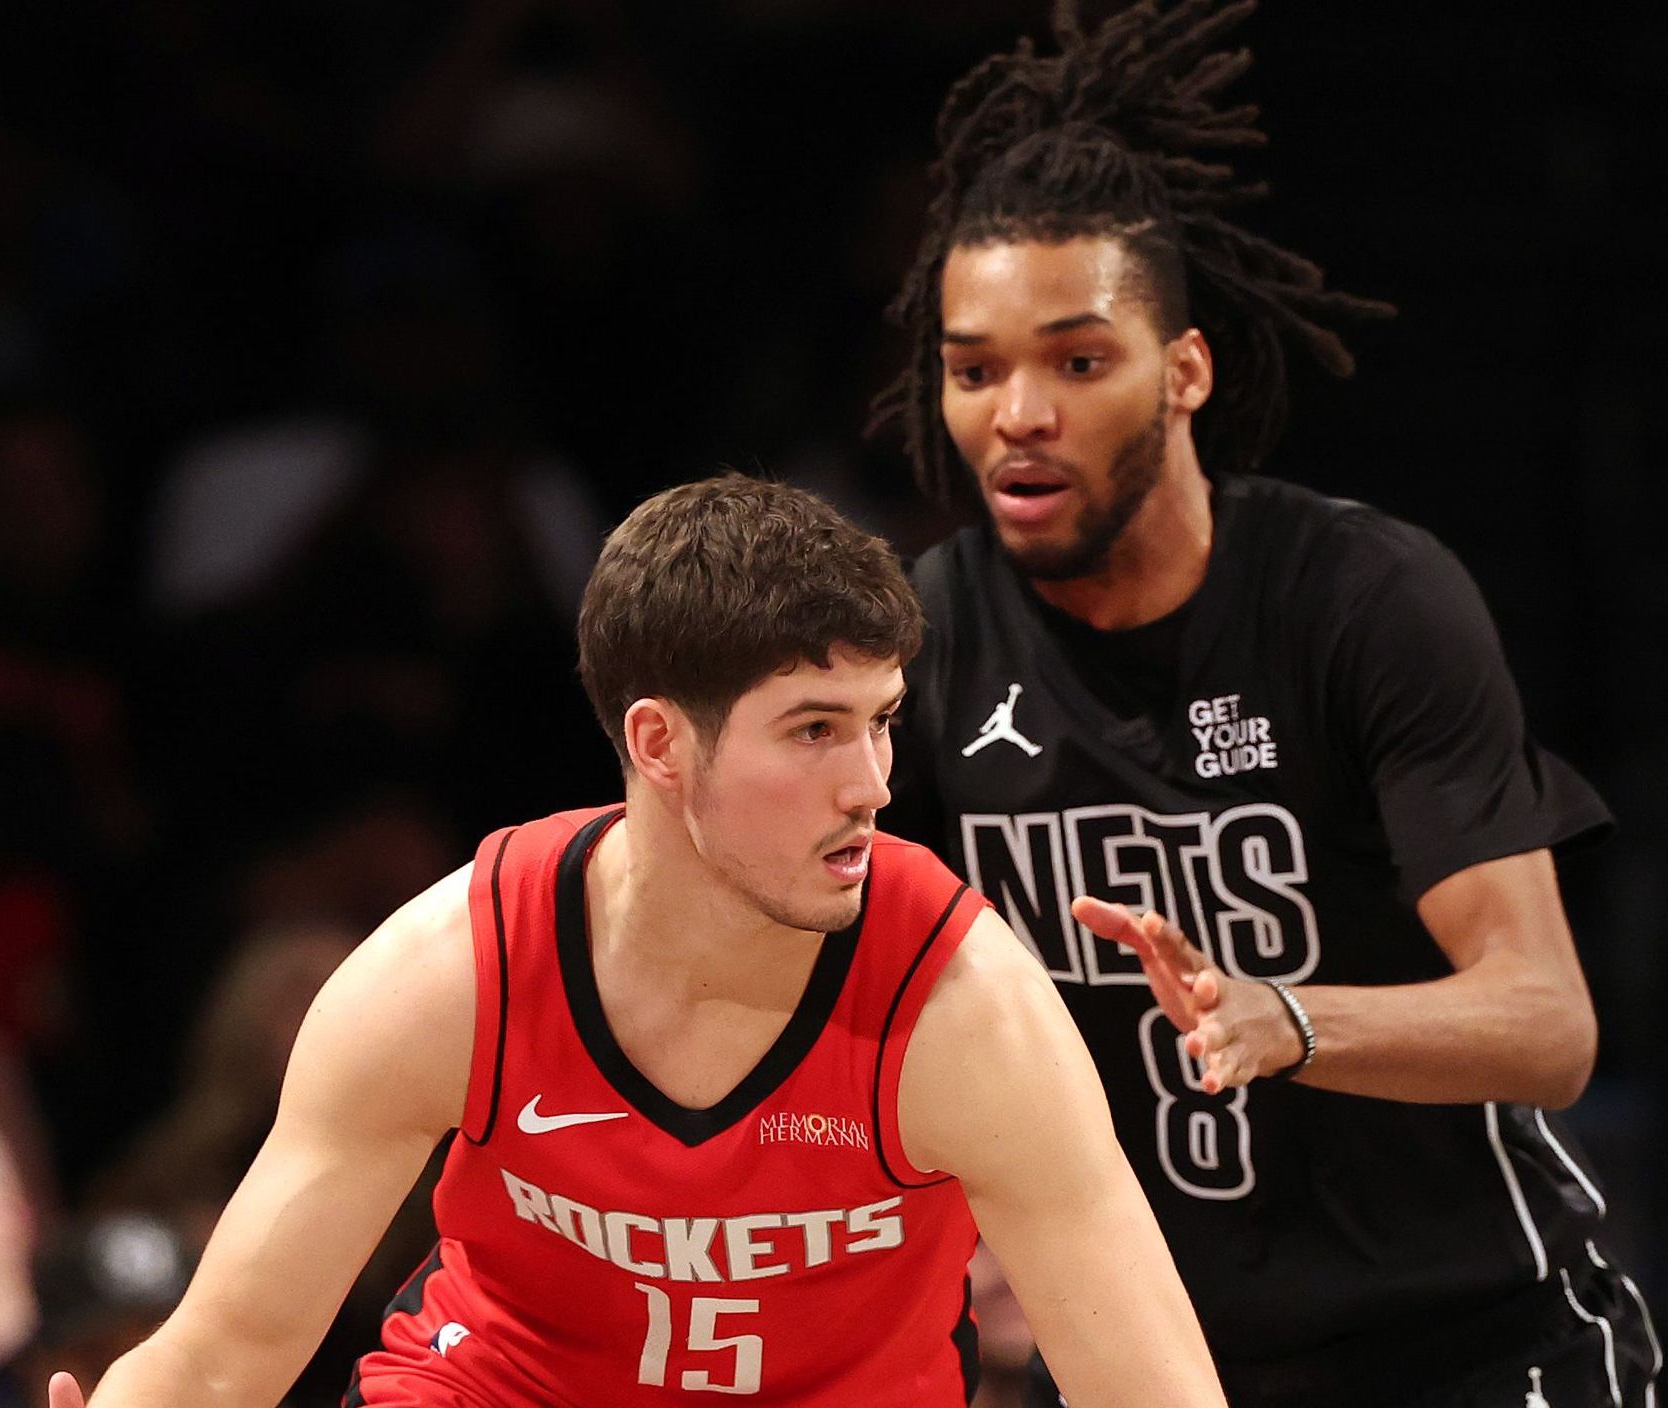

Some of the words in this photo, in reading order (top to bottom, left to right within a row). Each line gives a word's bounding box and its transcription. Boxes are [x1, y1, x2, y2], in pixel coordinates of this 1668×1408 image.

[1188, 694, 1240, 727] GET
[1191, 716, 1271, 752] YOUR
[960, 803, 1321, 986] NETS
[759, 1112, 868, 1139] MEMORIAL
[759, 1126, 869, 1151] HERMANN
[1138, 1005, 1257, 1201] 8
[499, 1167, 906, 1283] ROCKETS
[634, 1281, 764, 1395] 15
